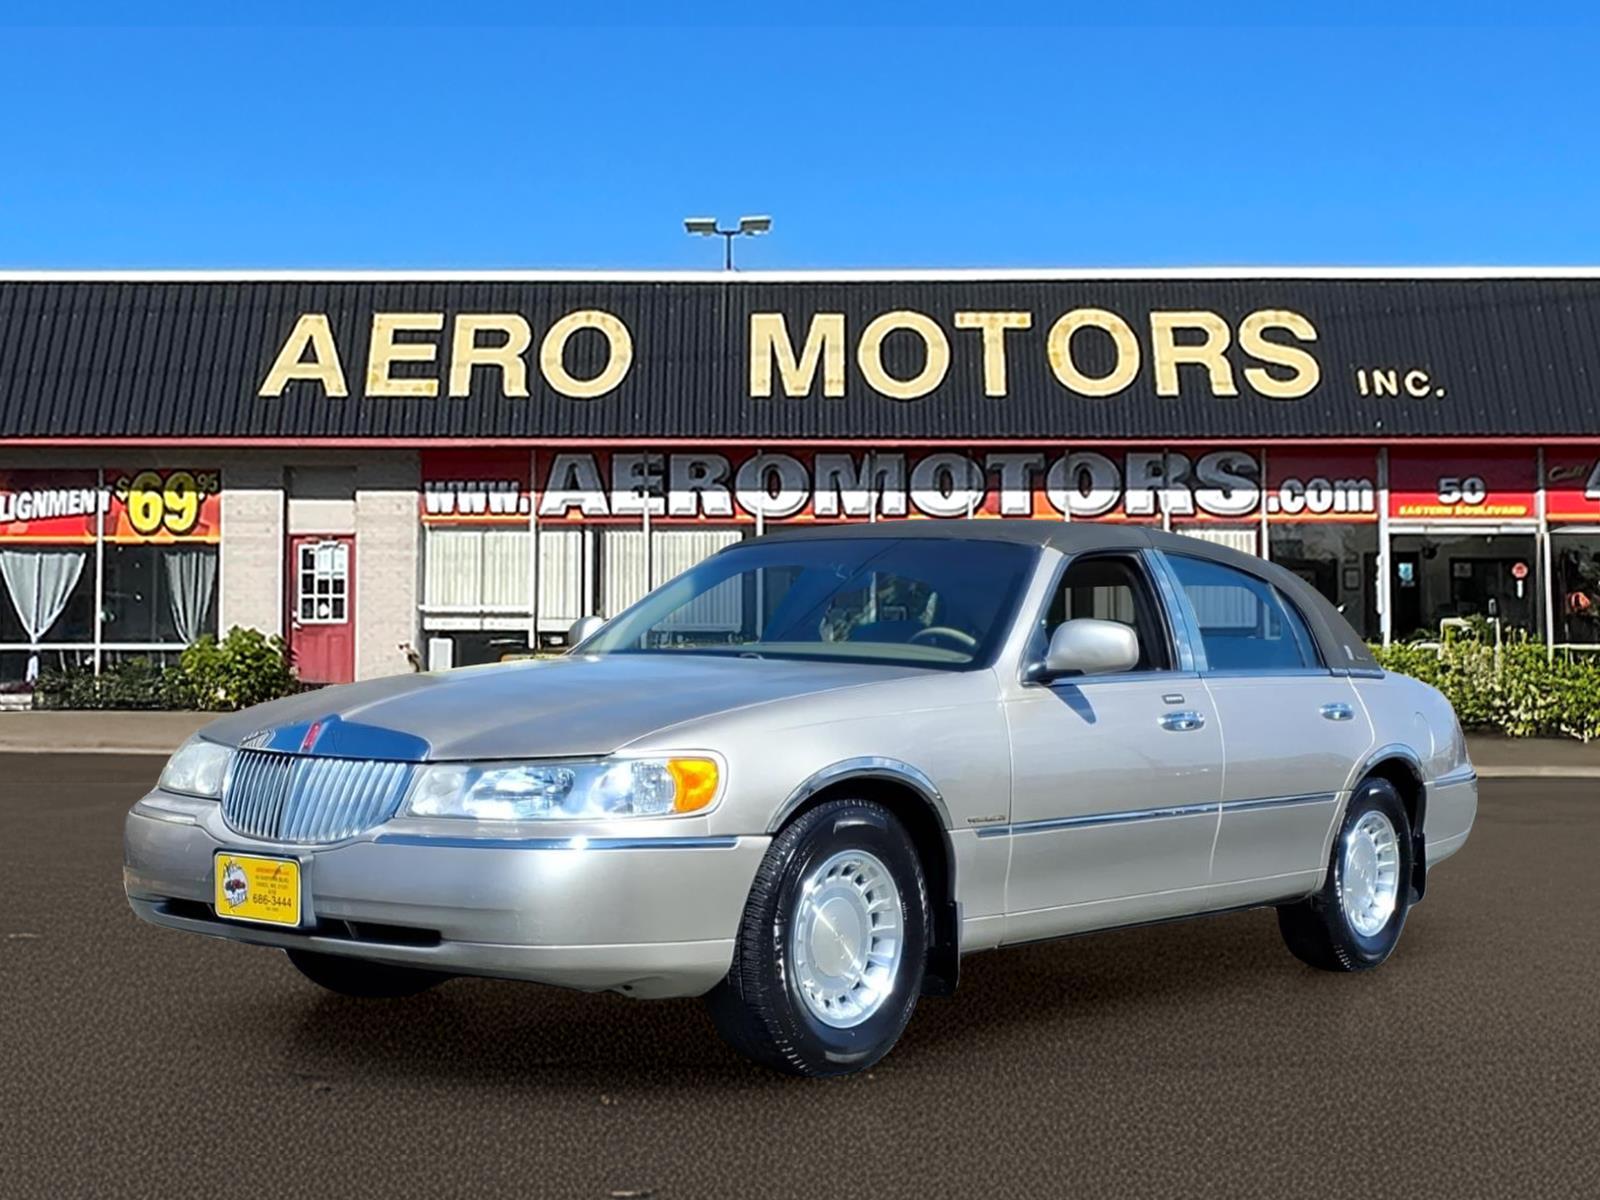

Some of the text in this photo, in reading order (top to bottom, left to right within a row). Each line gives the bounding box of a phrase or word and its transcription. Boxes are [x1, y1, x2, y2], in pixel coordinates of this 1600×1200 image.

[258, 308, 1447, 399] AERO MOTORS INC.
[1437, 477, 1486, 505] 50
[1399, 505, 1528, 516] EASTERN BOULEVARD
[252, 893, 292, 908] 686-3444
